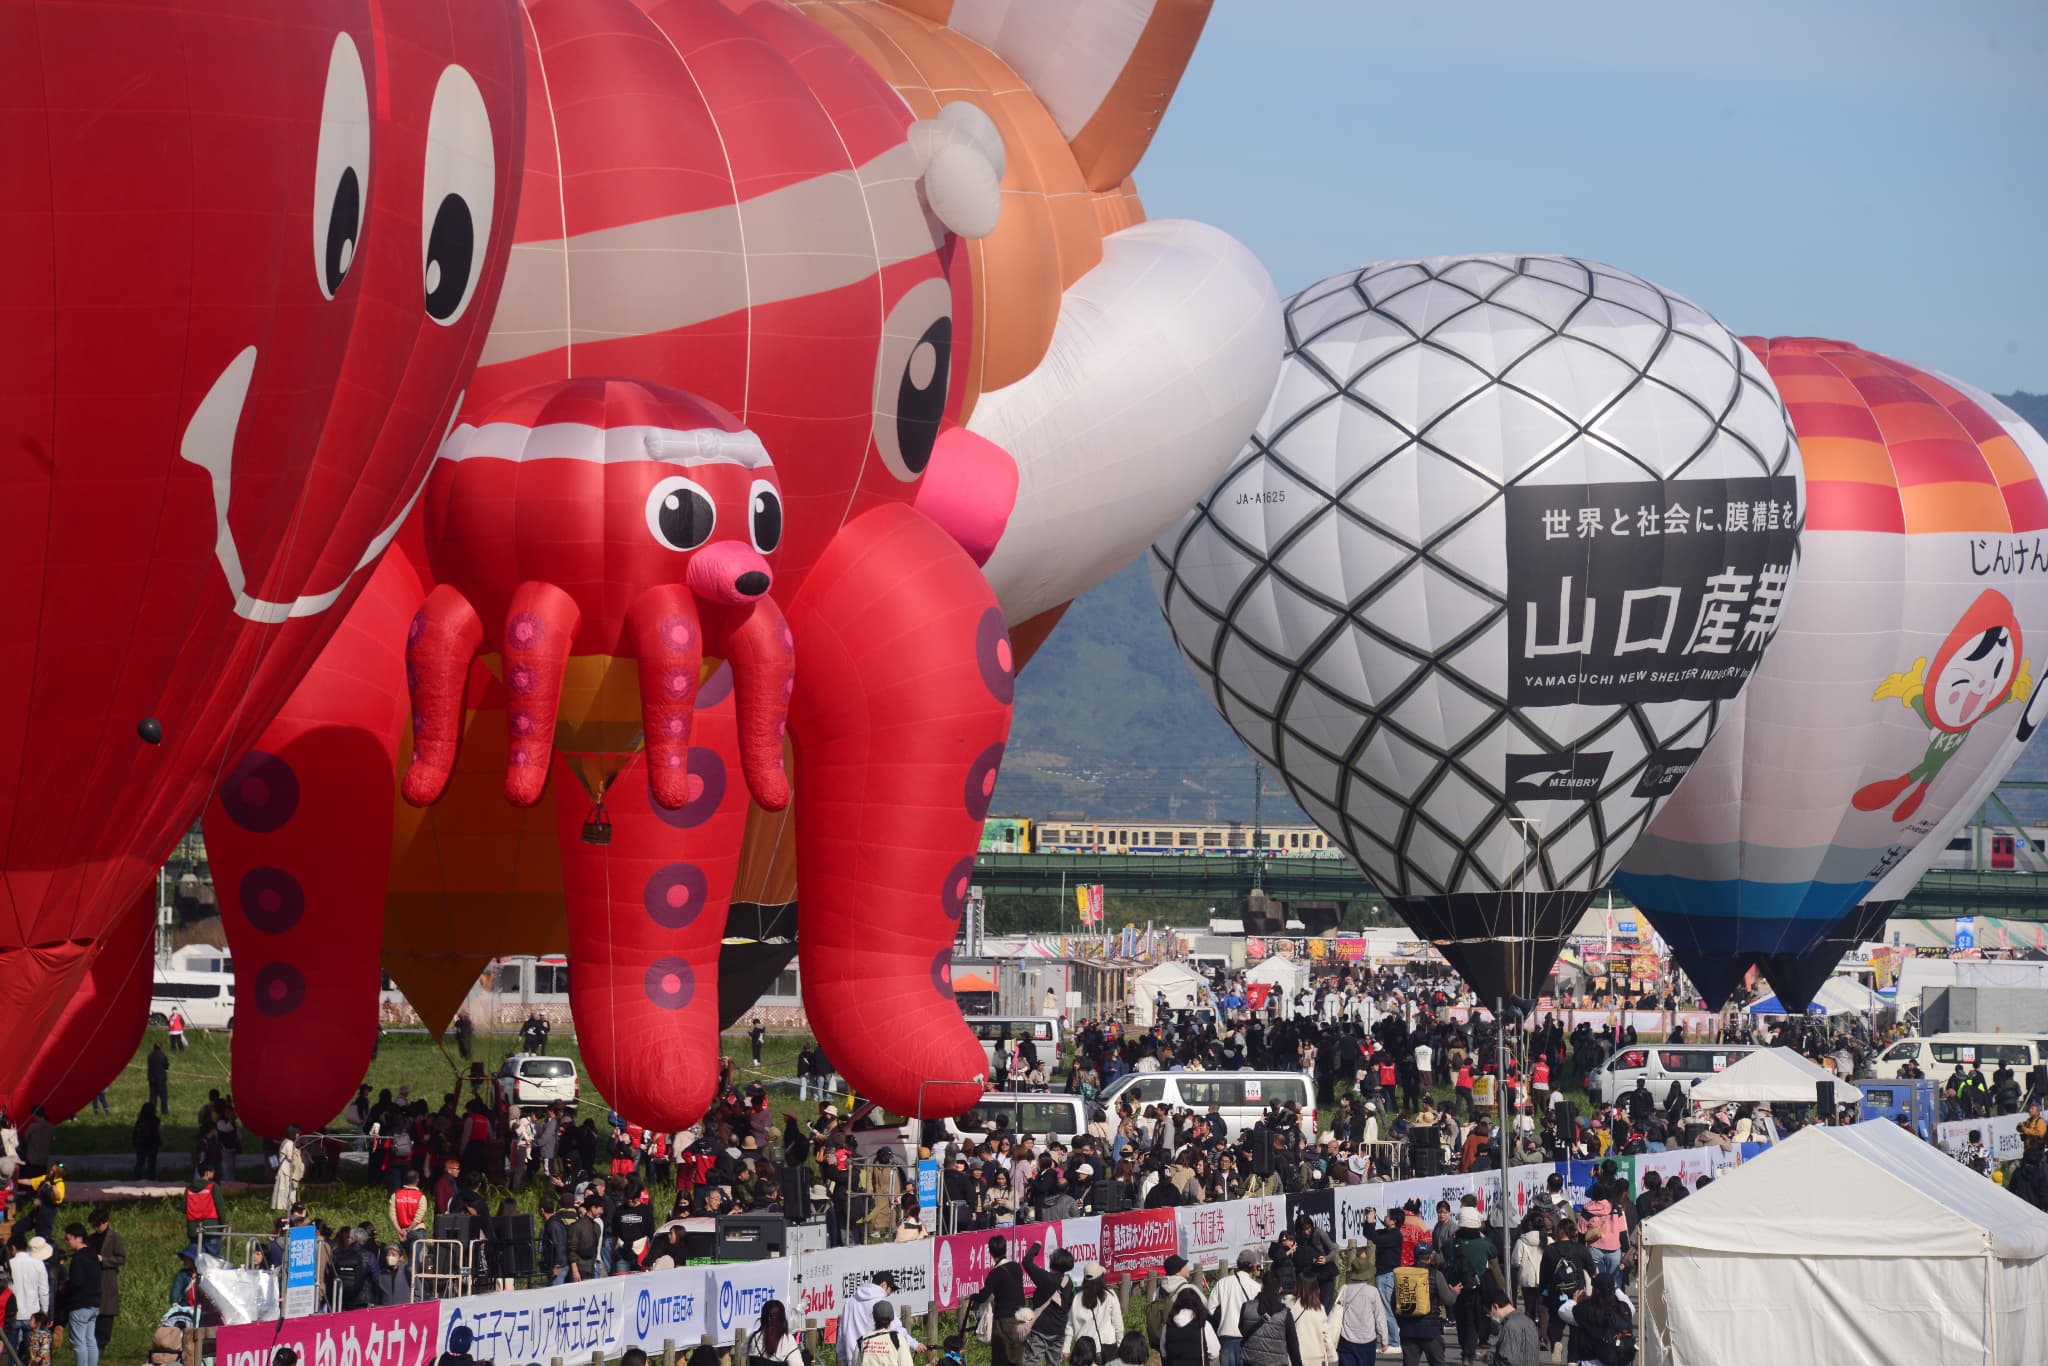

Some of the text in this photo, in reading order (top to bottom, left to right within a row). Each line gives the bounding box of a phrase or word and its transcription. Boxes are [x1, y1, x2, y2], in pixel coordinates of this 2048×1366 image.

[1236, 491, 1286, 504] JA-A1625
[1541, 499, 1797, 541] 世界と社会に、膜構造を。
[1524, 563, 1789, 658] 山口産業
[1524, 674, 1614, 686] YAMAGUCHI
[1618, 670, 1648, 684] NEW
[1650, 668, 1697, 682] SHELTER
[1700, 667, 1739, 680] INDUSTRY
[1549, 778, 1599, 787] MEMBRY
[1192, 1208, 1225, 1247] 大和証券
[652, 1292, 695, 1327] NTT西日本
